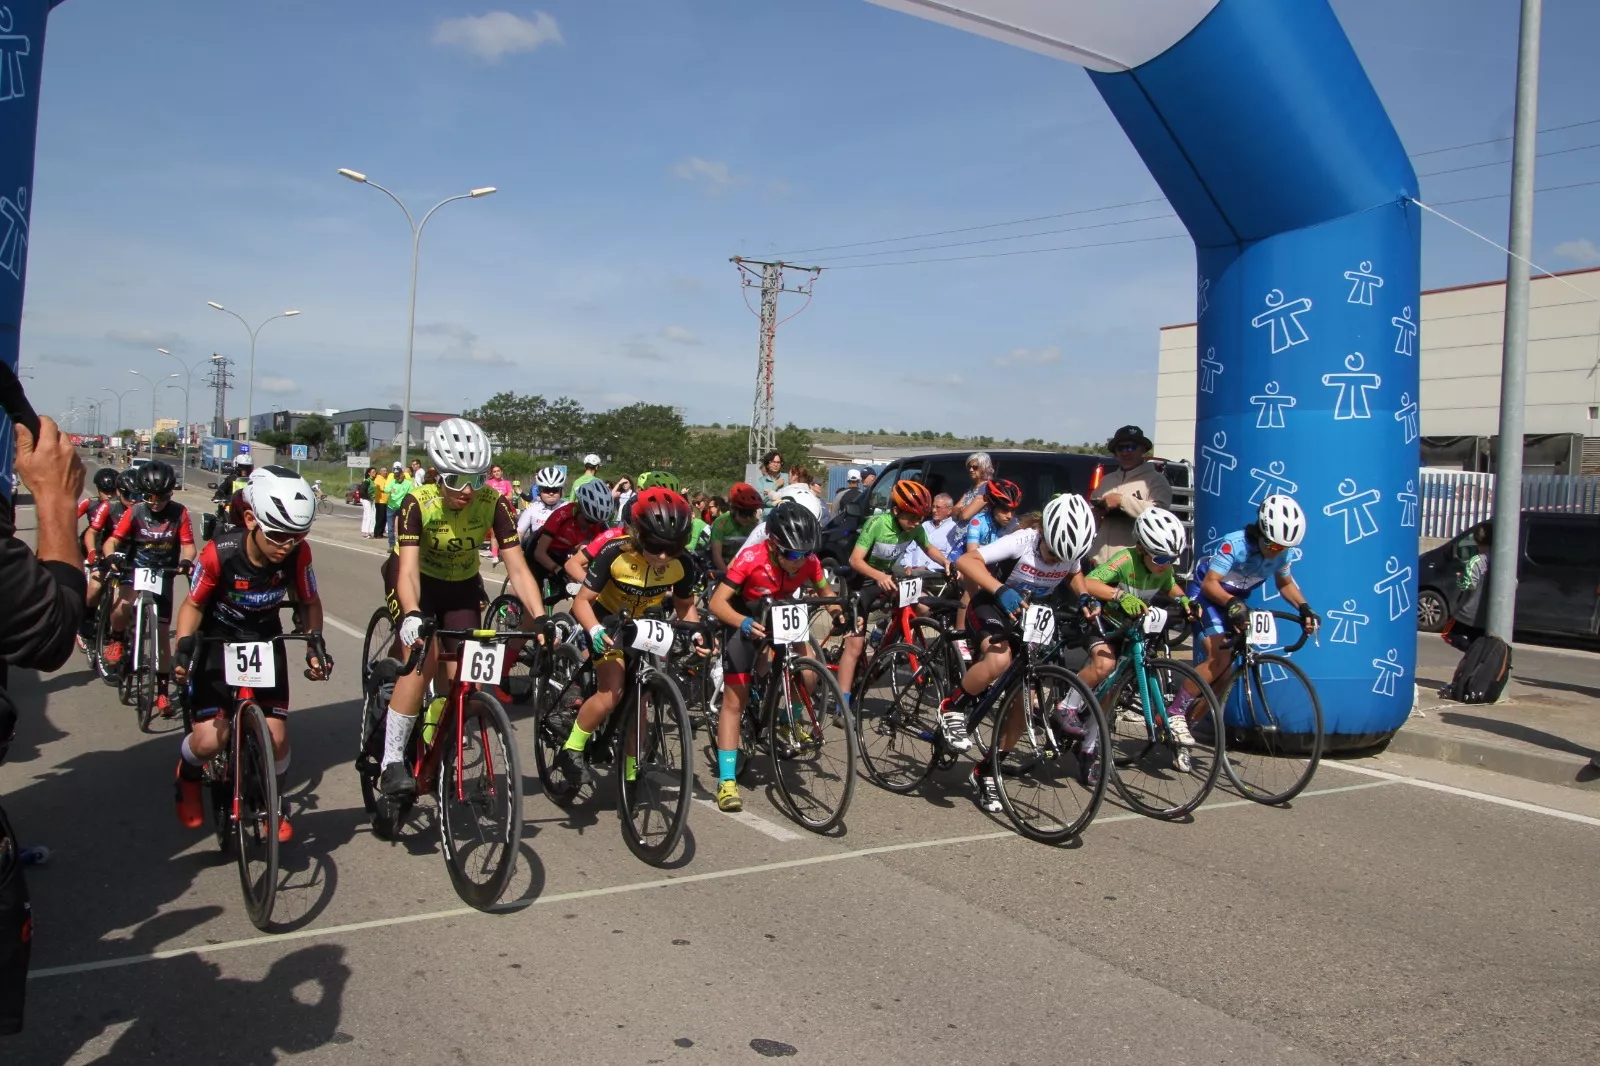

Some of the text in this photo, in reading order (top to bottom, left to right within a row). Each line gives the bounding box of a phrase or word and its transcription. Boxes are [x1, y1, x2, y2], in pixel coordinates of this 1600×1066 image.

[143, 569, 157, 584] 78
[905, 580, 917, 598] 73
[782, 607, 800, 631] 56
[1034, 607, 1052, 632] 58
[1255, 613, 1270, 634] 60
[644, 620, 664, 642] 75
[236, 645, 262, 673] 54
[470, 651, 495, 682] 63
